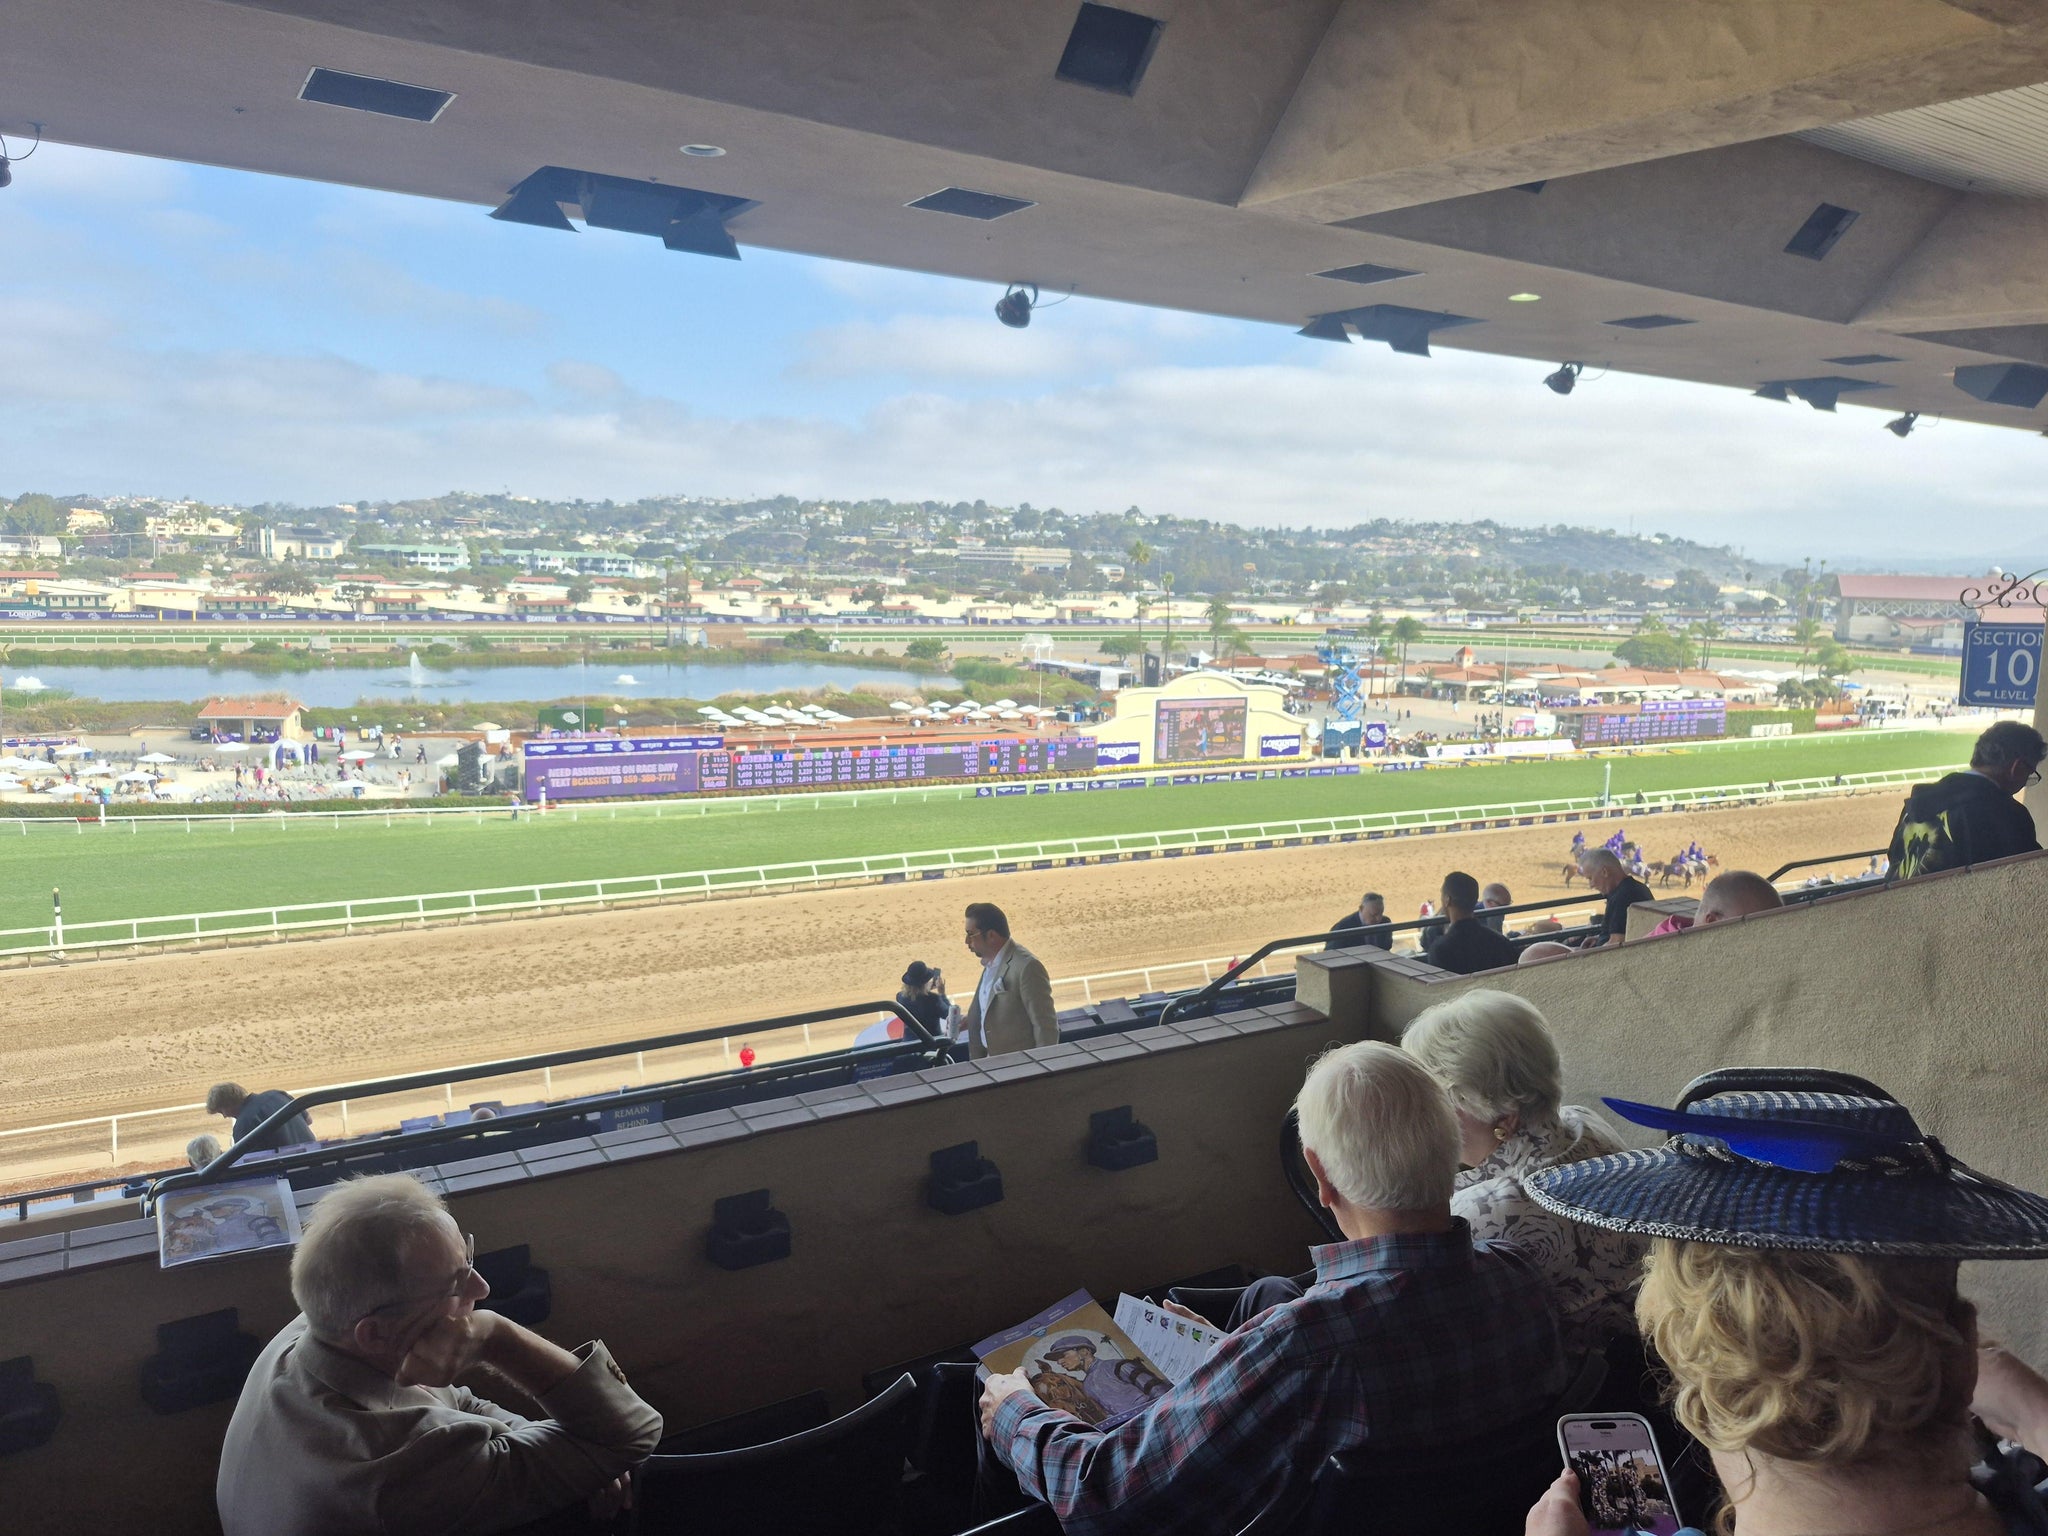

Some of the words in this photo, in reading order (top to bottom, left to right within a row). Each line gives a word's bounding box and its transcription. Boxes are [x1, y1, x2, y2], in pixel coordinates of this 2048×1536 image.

[1987, 649, 2034, 686] 10
[1994, 690, 2029, 700] LEVEL
[548, 767, 571, 777] NEED
[572, 766, 621, 776] ASSISTANCE
[622, 765, 635, 774] ON
[636, 764, 657, 773] RACE
[658, 763, 678, 772] DAY?
[551, 778, 570, 787] TEXT
[611, 775, 622, 784] TO
[614, 1105, 650, 1119] REMAIN
[616, 1118, 649, 1131] BEHIND
